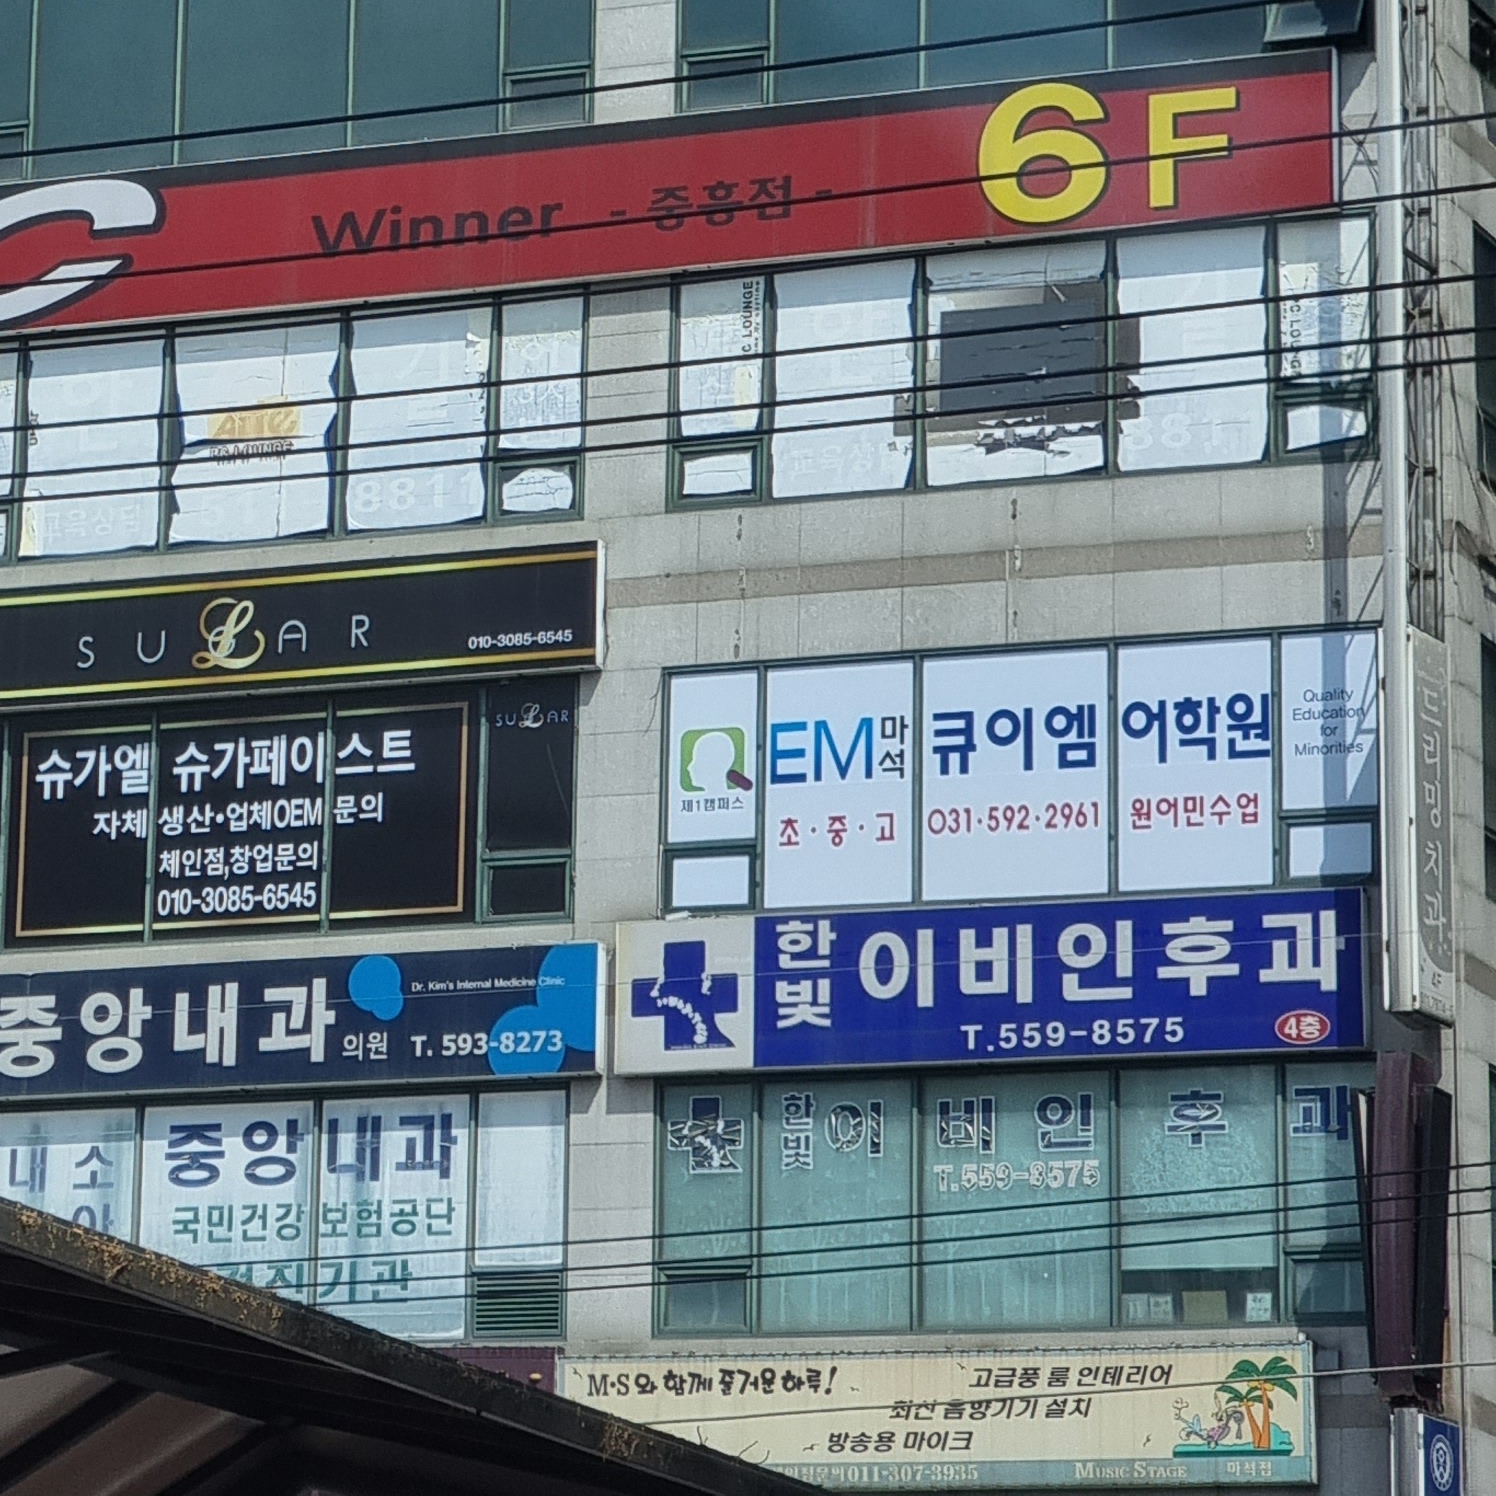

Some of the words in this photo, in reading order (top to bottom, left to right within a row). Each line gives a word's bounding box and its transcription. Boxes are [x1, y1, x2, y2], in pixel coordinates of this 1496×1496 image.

[311, 202, 564, 255] Winner
[467, 629, 573, 650] 010-3085-6545
[1303, 687, 1354, 703] Quality
[1293, 705, 1364, 721] Education
[931, 703, 1098, 778] 큐이엠
[1121, 692, 1271, 766] 어학원
[1320, 724, 1338, 737] for
[879, 715, 909, 780] 마석
[1295, 742, 1364, 757] Minorities
[35, 740, 150, 801] 슈가엘
[172, 728, 416, 794] 슈가페이스트
[92, 809, 147, 840] 자체
[333, 791, 384, 824] 문의
[680, 796, 745, 813] 제1캠퍼스
[1130, 791, 1261, 831] 원어민수업
[157, 883, 317, 917] 010-3085-6545
[858, 909, 1345, 1010] 이비인후과
[411, 981, 426, 993] Dr.
[428, 979, 454, 992] Kim's
[457, 978, 492, 990] Internal
[494, 977, 537, 989] Medicine
[538, 975, 566, 987] Clinic
[775, 920, 837, 1029] 한빛
[1283, 1013, 1323, 1042] 4층
[342, 1031, 388, 1061] 의원
[411, 1035, 433, 1057] T.
[442, 1030, 563, 1055] 593-8273
[781, 1091, 816, 1170] 한빛
[164, 1113, 459, 1188] 중앙내과
[662, 1369, 713, 1396] 함께
[718, 1367, 777, 1397] 즐거운
[781, 1365, 838, 1396] 하루!
[968, 1366, 1041, 1388] 고급풍
[1046, 1366, 1070, 1387] 룸
[1076, 1364, 1174, 1388] 인테리어
[942, 1397, 1041, 1421] 음향기기
[1044, 1397, 1093, 1419] 설치
[827, 1431, 896, 1453] 방송용
[903, 1429, 974, 1453] 마이크
[1226, 1459, 1273, 1478] 마석점
